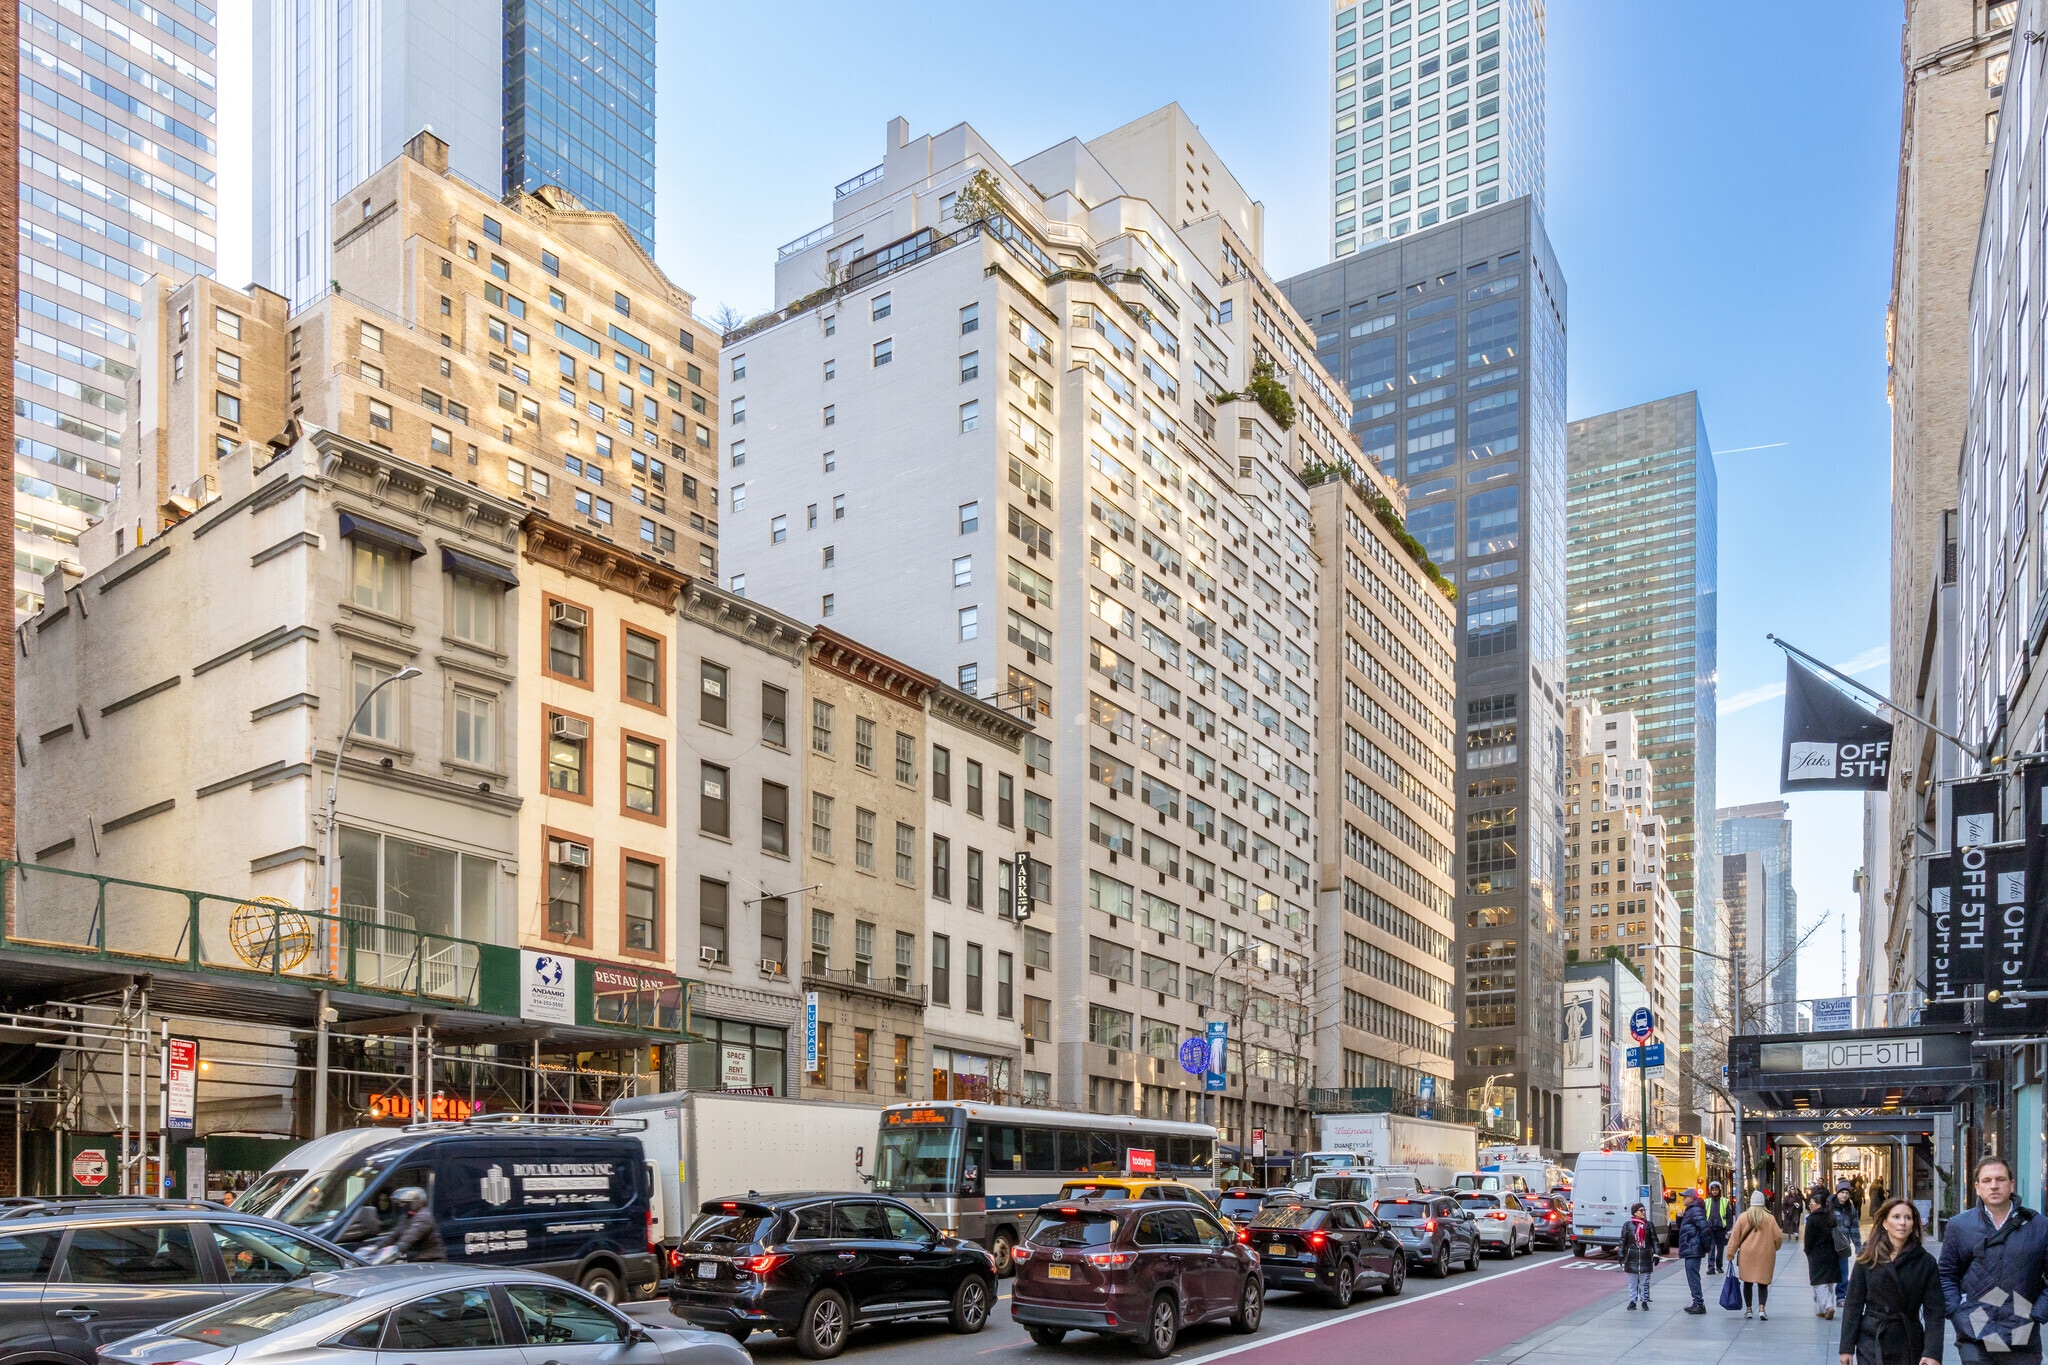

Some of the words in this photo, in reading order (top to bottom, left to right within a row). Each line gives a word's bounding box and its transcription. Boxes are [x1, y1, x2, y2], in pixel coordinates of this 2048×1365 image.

[1839, 741, 1890, 760] OFF
[1789, 750, 1831, 772] Saks
[1840, 760, 1887, 778] 5TH
[1017, 854, 1028, 897] PARK
[1962, 847, 1986, 897] OFF
[1960, 903, 1985, 949] 5TH
[594, 970, 664, 989] RESTAURANT
[531, 987, 565, 998] ANDAMIO
[1820, 999, 1850, 1012] Skyline
[808, 1007, 816, 1060] LUGGAGE
[727, 1051, 746, 1060] SPACE
[1831, 1045, 1873, 1066] OFF
[1877, 1042, 1919, 1064] 5TH
[172, 1070, 178, 1080] 3
[1334, 1126, 1373, 1137] Walgreens
[1401, 1144, 1435, 1173] Walgreens
[512, 1164, 549, 1177] ROYAL
